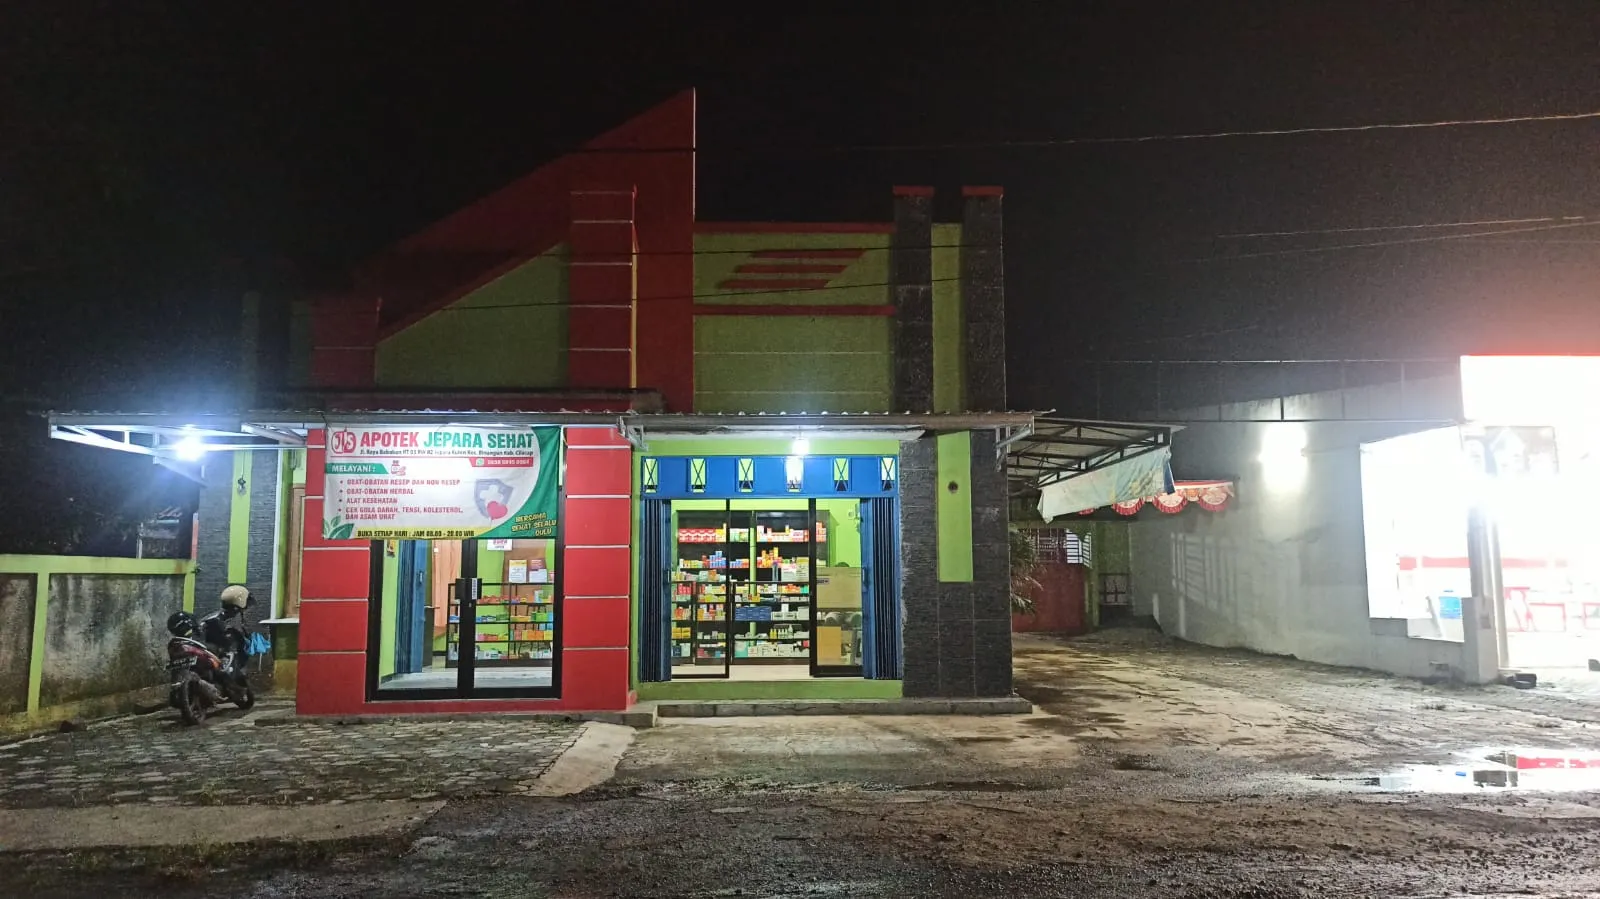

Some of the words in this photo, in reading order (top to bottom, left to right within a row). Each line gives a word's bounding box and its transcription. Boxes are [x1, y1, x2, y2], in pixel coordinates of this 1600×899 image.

[360, 432, 419, 447] APOTEK
[423, 432, 483, 448] JEPARA
[487, 433, 534, 448] SEHAT
